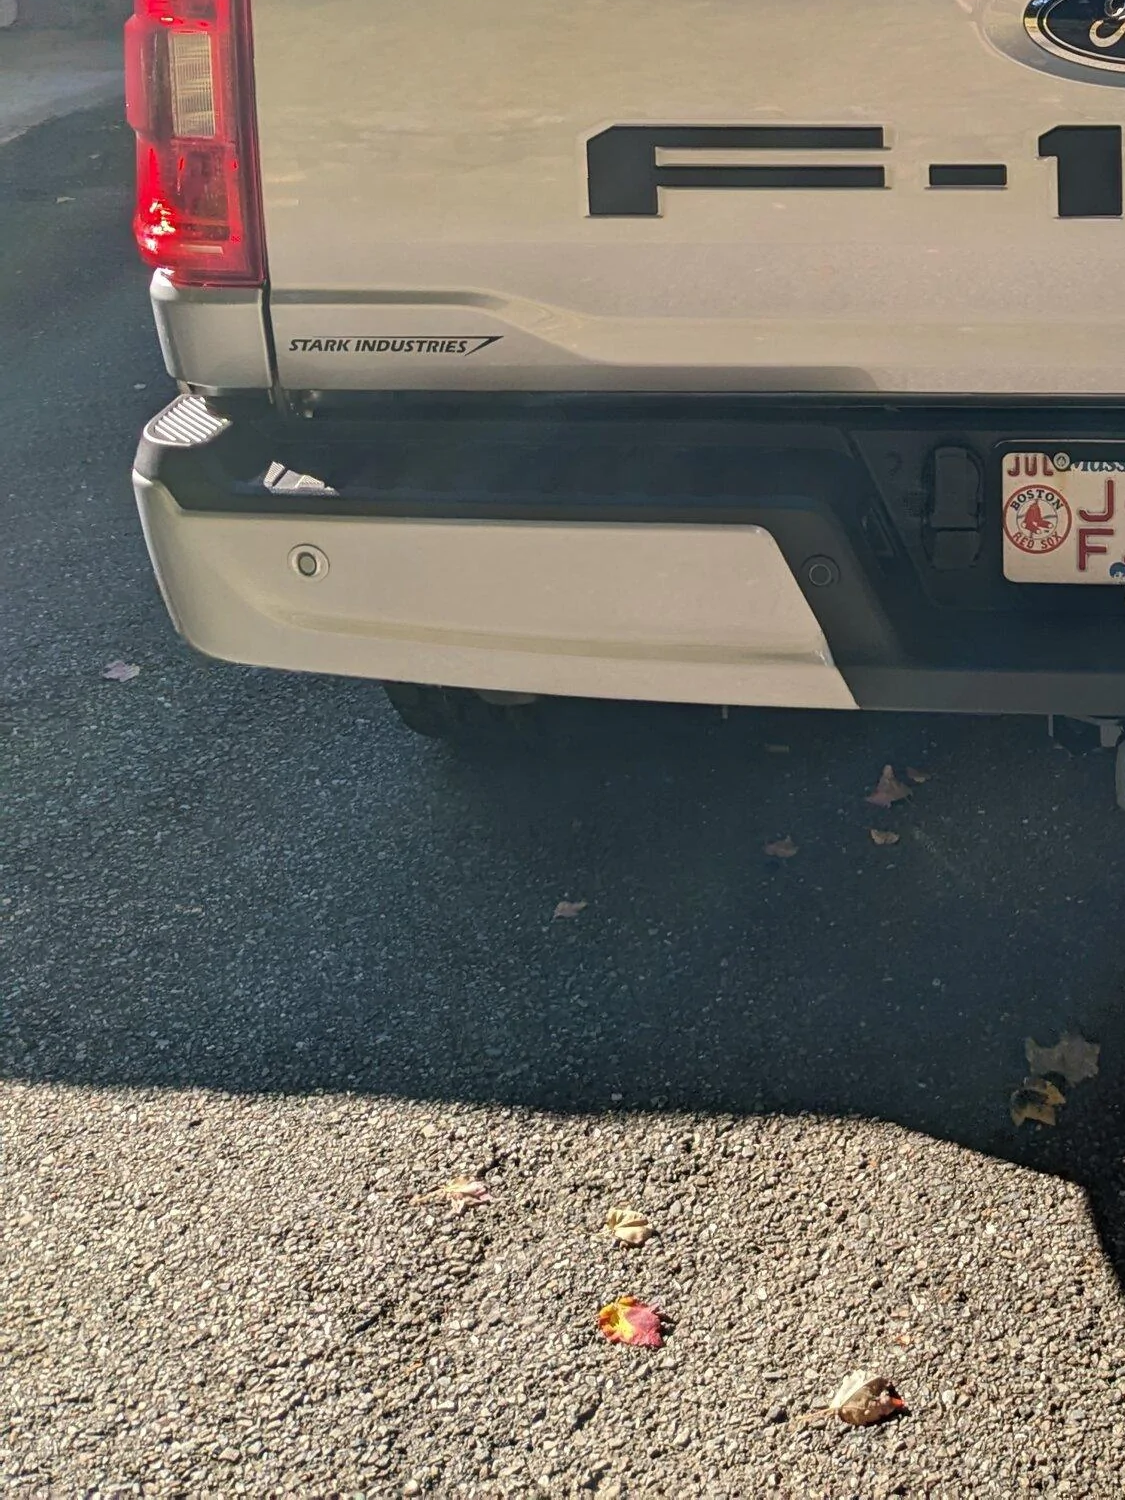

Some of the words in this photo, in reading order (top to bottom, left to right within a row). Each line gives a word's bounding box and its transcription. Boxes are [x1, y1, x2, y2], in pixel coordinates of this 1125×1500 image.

[289, 338, 350, 353] STARK
[354, 339, 469, 354] INDUSTRIES
[1007, 455, 1054, 477] JUL
[1010, 489, 1064, 512] BOSTON
[1012, 531, 1035, 549] RED
[1040, 530, 1062, 549] SOX
